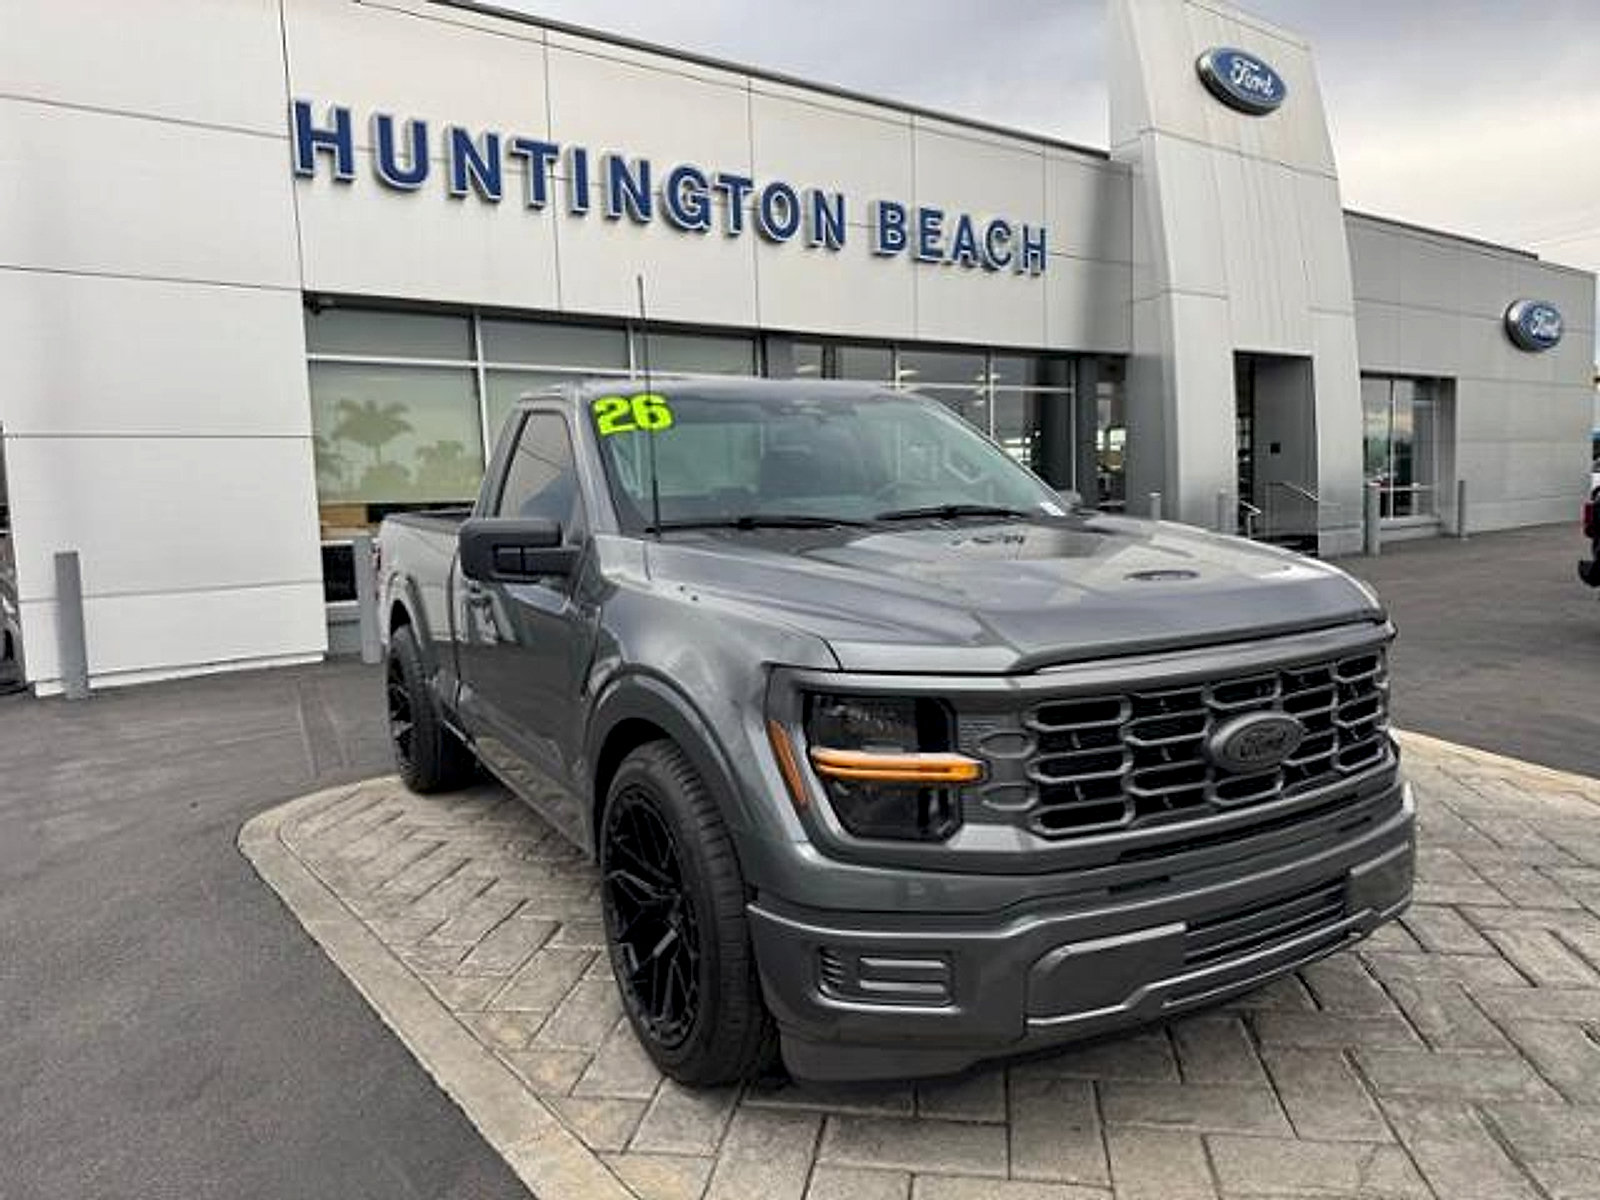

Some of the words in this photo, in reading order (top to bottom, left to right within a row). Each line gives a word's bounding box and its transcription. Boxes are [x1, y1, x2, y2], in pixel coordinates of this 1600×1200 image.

[1229, 57, 1274, 97] Ford
[293, 99, 847, 251] HUNTINGTON
[876, 200, 1047, 275] BEACH
[594, 394, 672, 434] 26
